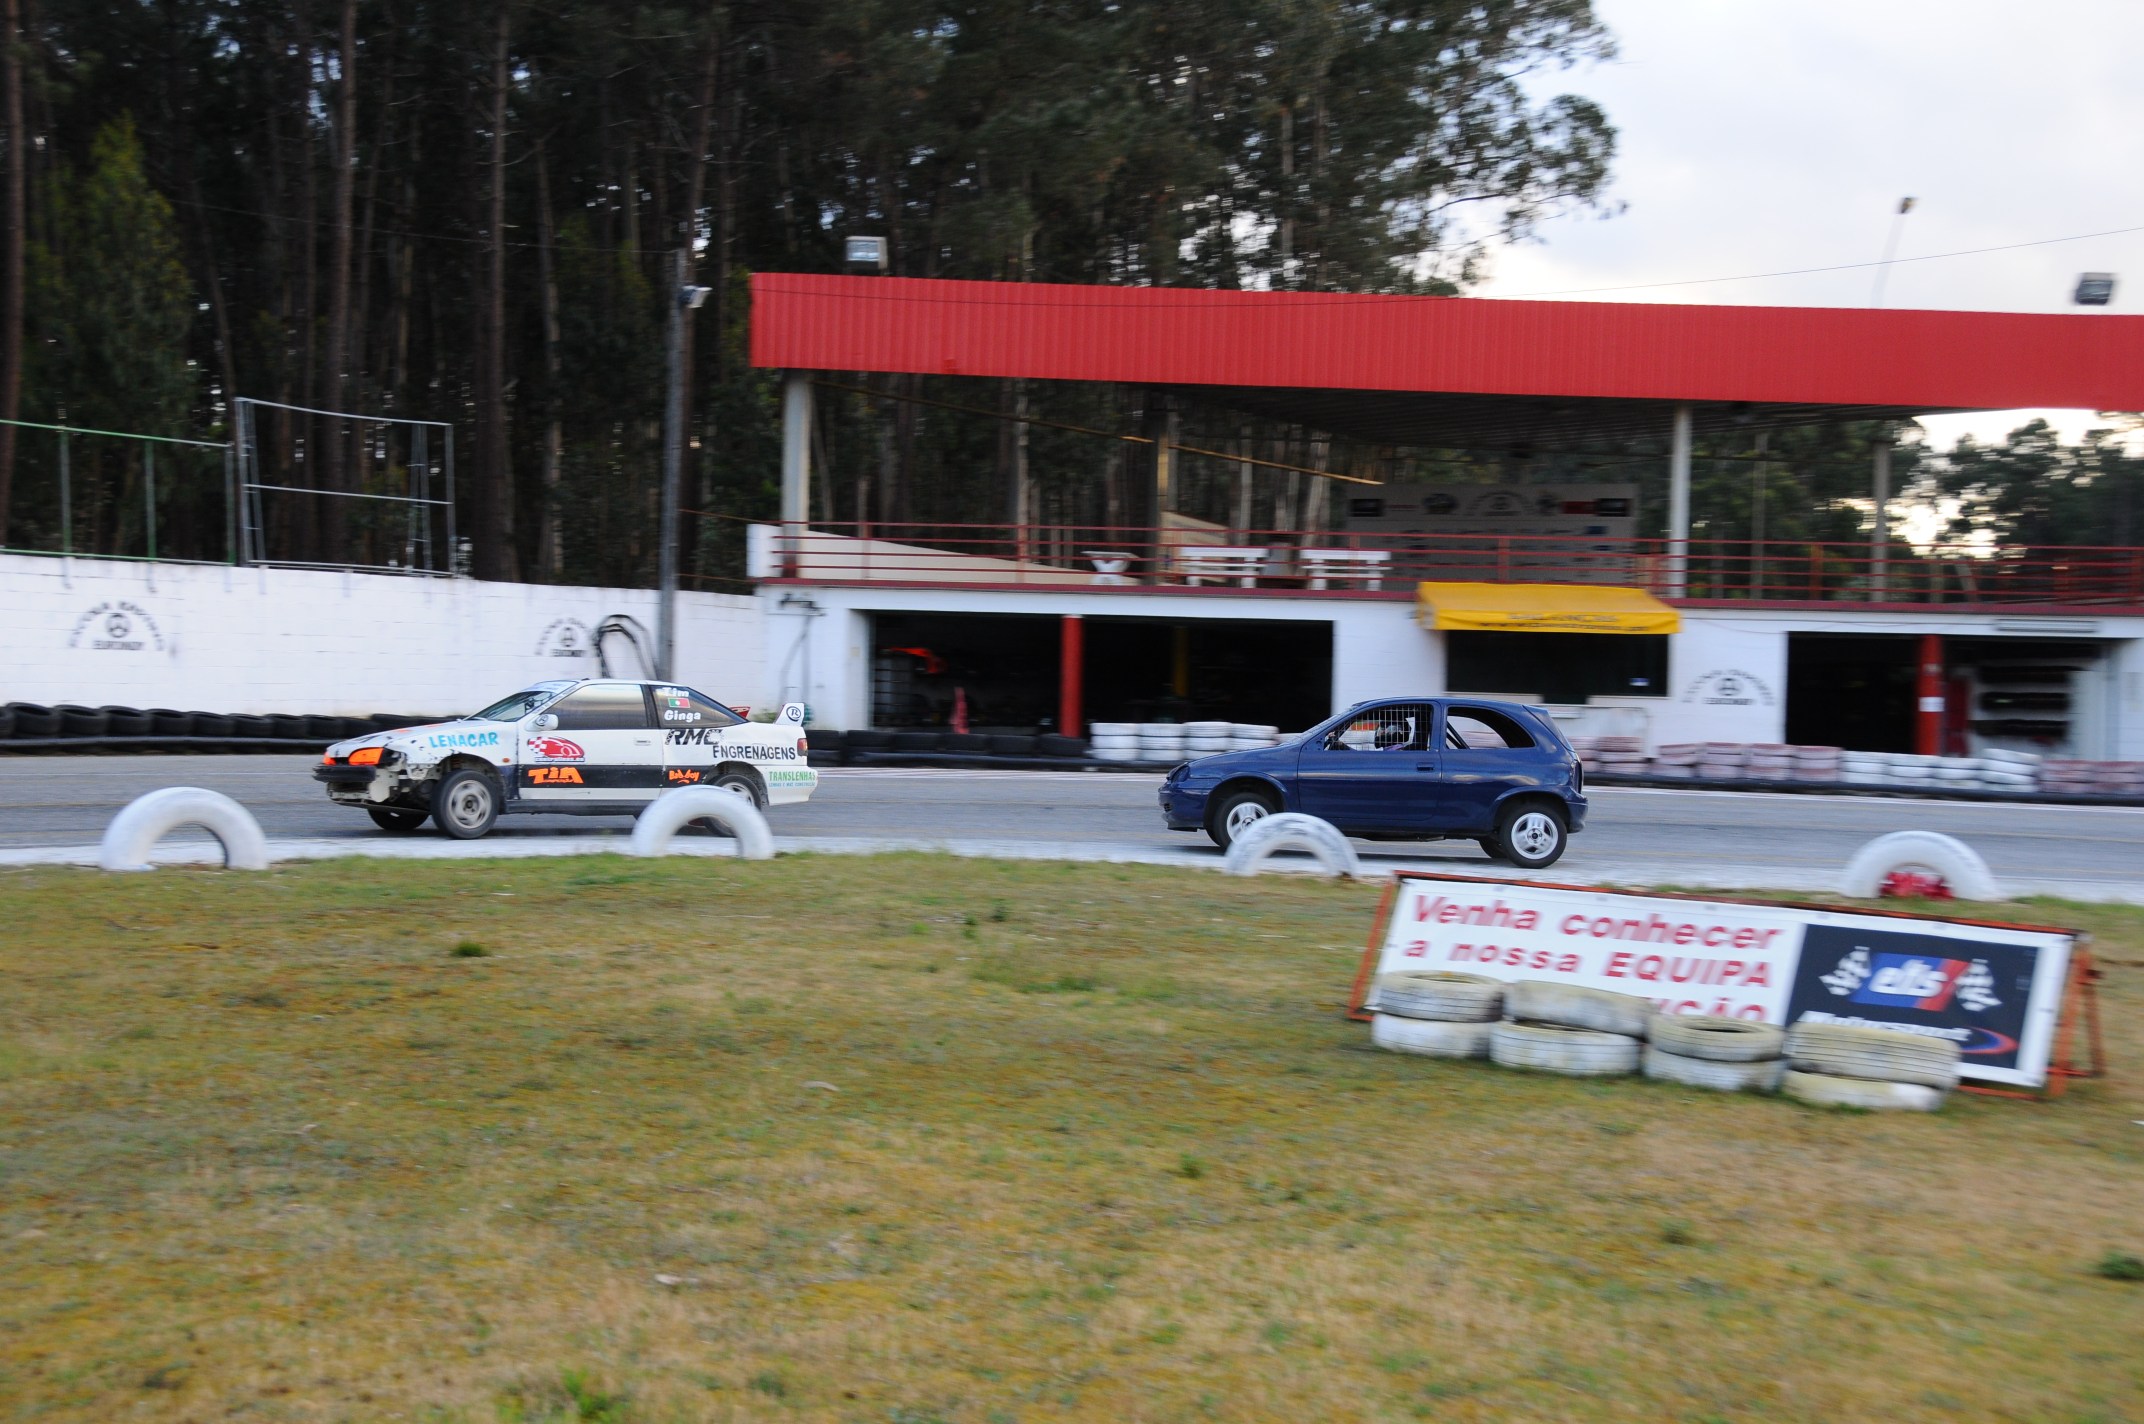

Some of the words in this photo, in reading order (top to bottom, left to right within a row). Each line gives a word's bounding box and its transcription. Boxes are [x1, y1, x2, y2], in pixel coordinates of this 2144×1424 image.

[662, 687, 689, 697] Tim
[664, 710, 701, 723] Ginga
[429, 732, 498, 748] LENACAR
[713, 745, 796, 760] ENGRENAGENS
[769, 771, 815, 781] TRANSLENHAS
[1414, 895, 1539, 931] Venha
[1561, 913, 1783, 949] conhecer
[1405, 940, 1428, 958] a
[1449, 943, 1580, 973] nossa
[1601, 952, 1771, 987] EQUIPA
